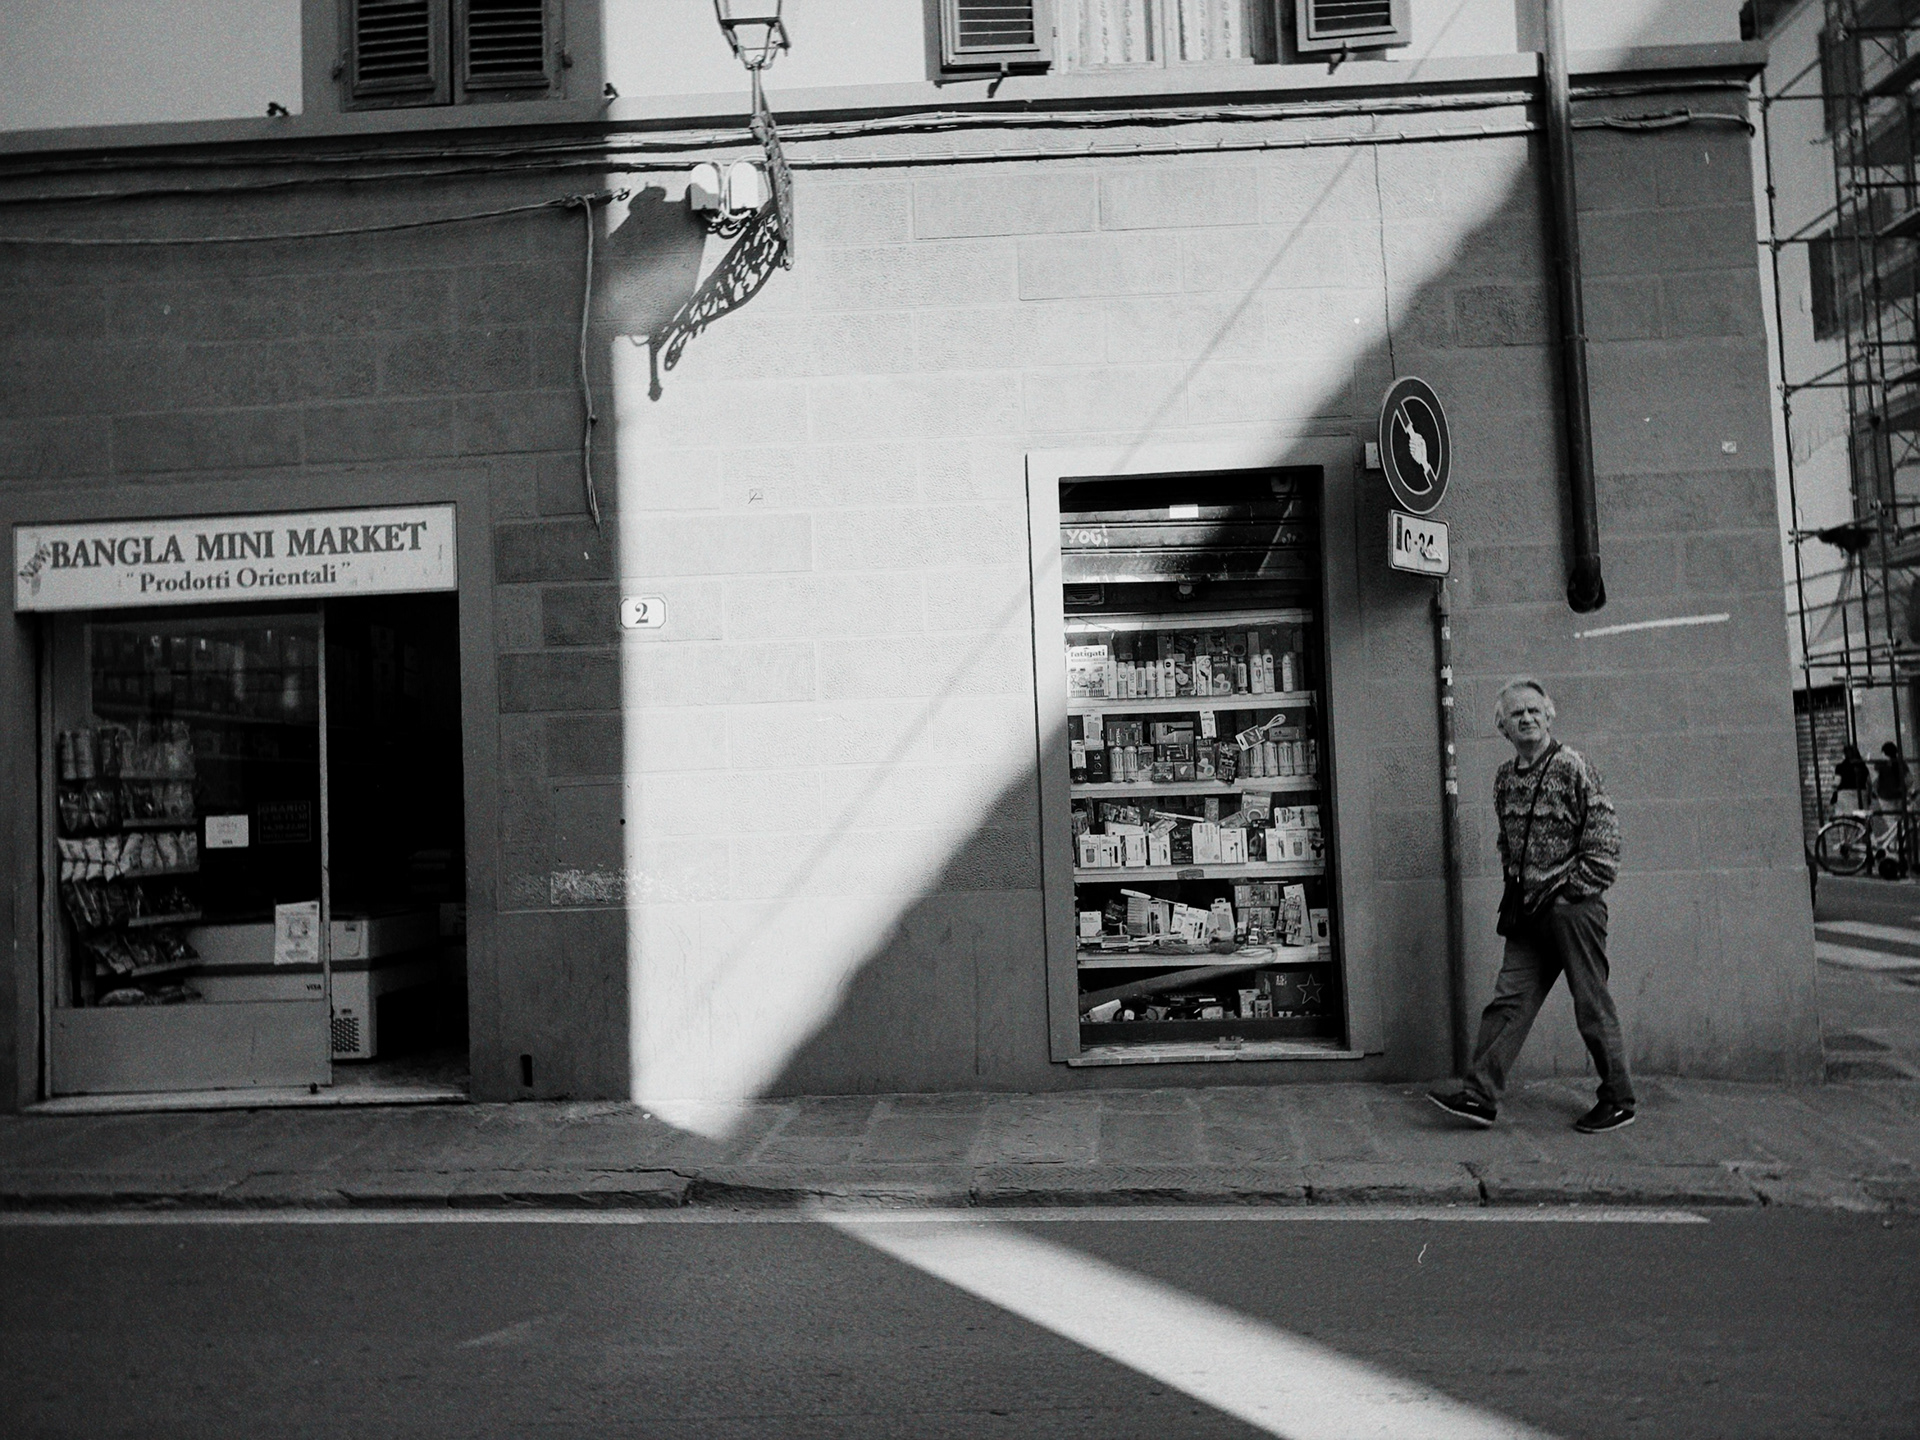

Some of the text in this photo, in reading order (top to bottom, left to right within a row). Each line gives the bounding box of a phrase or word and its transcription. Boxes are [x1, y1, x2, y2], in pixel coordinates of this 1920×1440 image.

[50, 521, 427, 569] BANGLA MINI MARKET
[634, 602, 649, 624] 2
